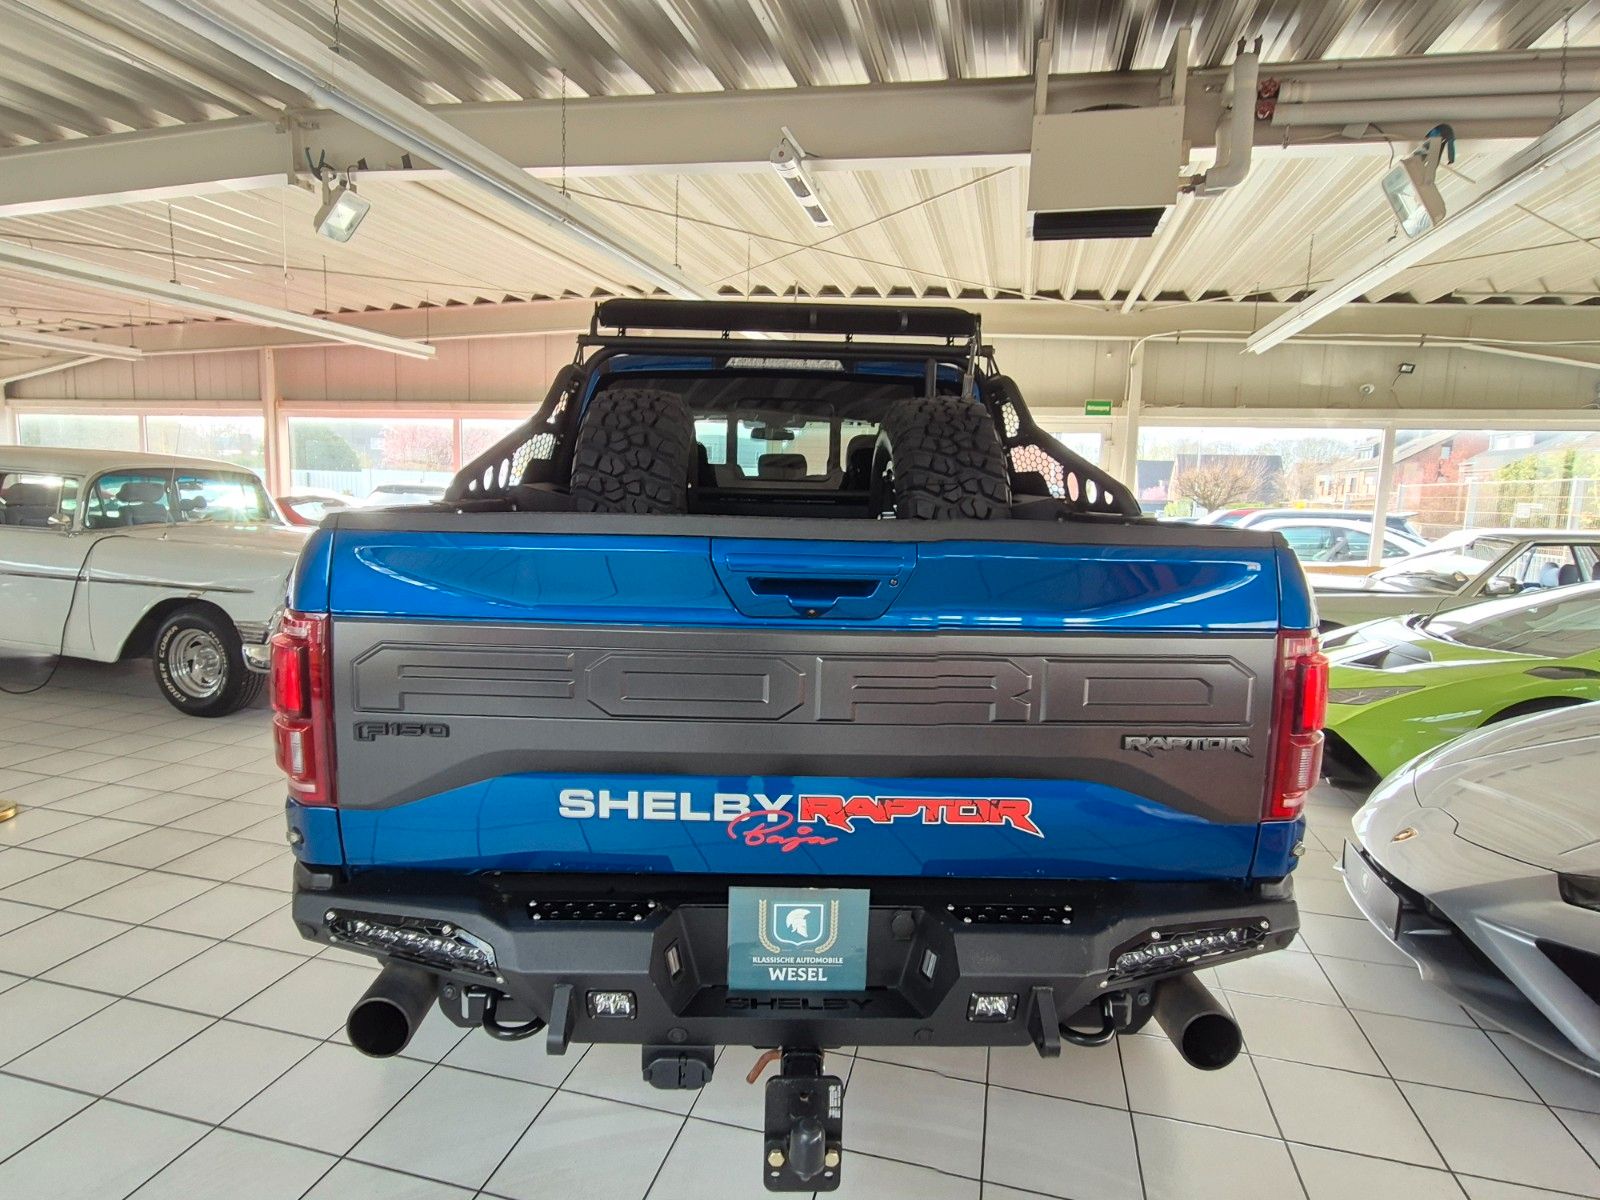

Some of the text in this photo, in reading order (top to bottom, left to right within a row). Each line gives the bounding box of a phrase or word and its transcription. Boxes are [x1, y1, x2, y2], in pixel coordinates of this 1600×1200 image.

[158, 625, 187, 703] COOPER COBRA
[351, 640, 1254, 724] FORD
[1120, 734, 1254, 758] RAPTOR
[558, 788, 1045, 839] SHELBY RAPTOR
[752, 956, 844, 964] KLASSISCHE AUTOMOBILE
[768, 967, 828, 982] WESEL
[724, 997, 873, 1010] SHELBY
